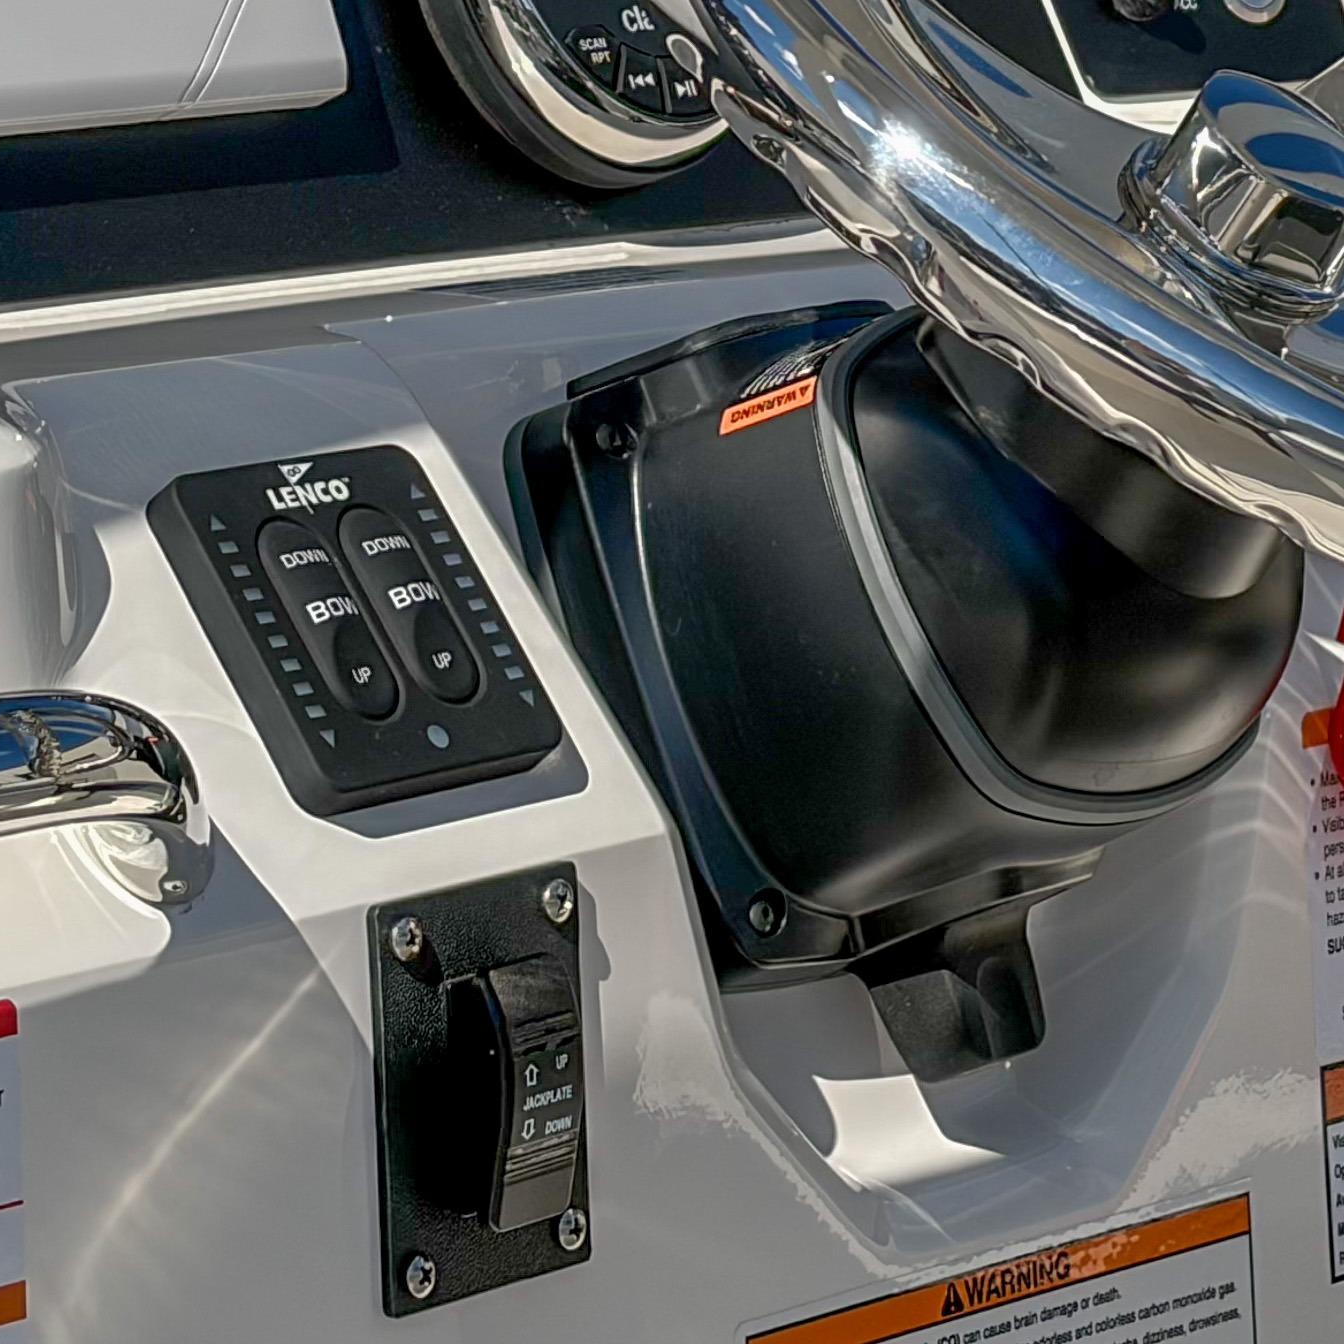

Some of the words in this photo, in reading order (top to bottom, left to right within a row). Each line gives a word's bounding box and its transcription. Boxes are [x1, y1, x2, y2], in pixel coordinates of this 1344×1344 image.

[579, 38, 607, 51] SCAN
[730, 389, 797, 423] WARNING
[265, 478, 351, 511] LENCO
[279, 548, 329, 570] DOWN
[361, 535, 411, 556] DOWN
[305, 595, 358, 624] BOW
[387, 580, 442, 610] BOW
[352, 667, 371, 684] UP
[432, 652, 452, 670] UP
[555, 1053, 568, 1070] UP
[523, 1084, 572, 1111] JACKPLATE
[545, 1115, 572, 1135] DOWN
[964, 1251, 1071, 1308] WARNING
[983, 1322, 1012, 1339] cause
[1013, 1312, 1038, 1330] brain
[1040, 1302, 1078, 1322] damage
[1075, 1322, 1093, 1340] and
[1095, 1312, 1136, 1334] colorless
[1138, 1300, 1170, 1320] carbon
[1172, 1286, 1217, 1310] monoxide
